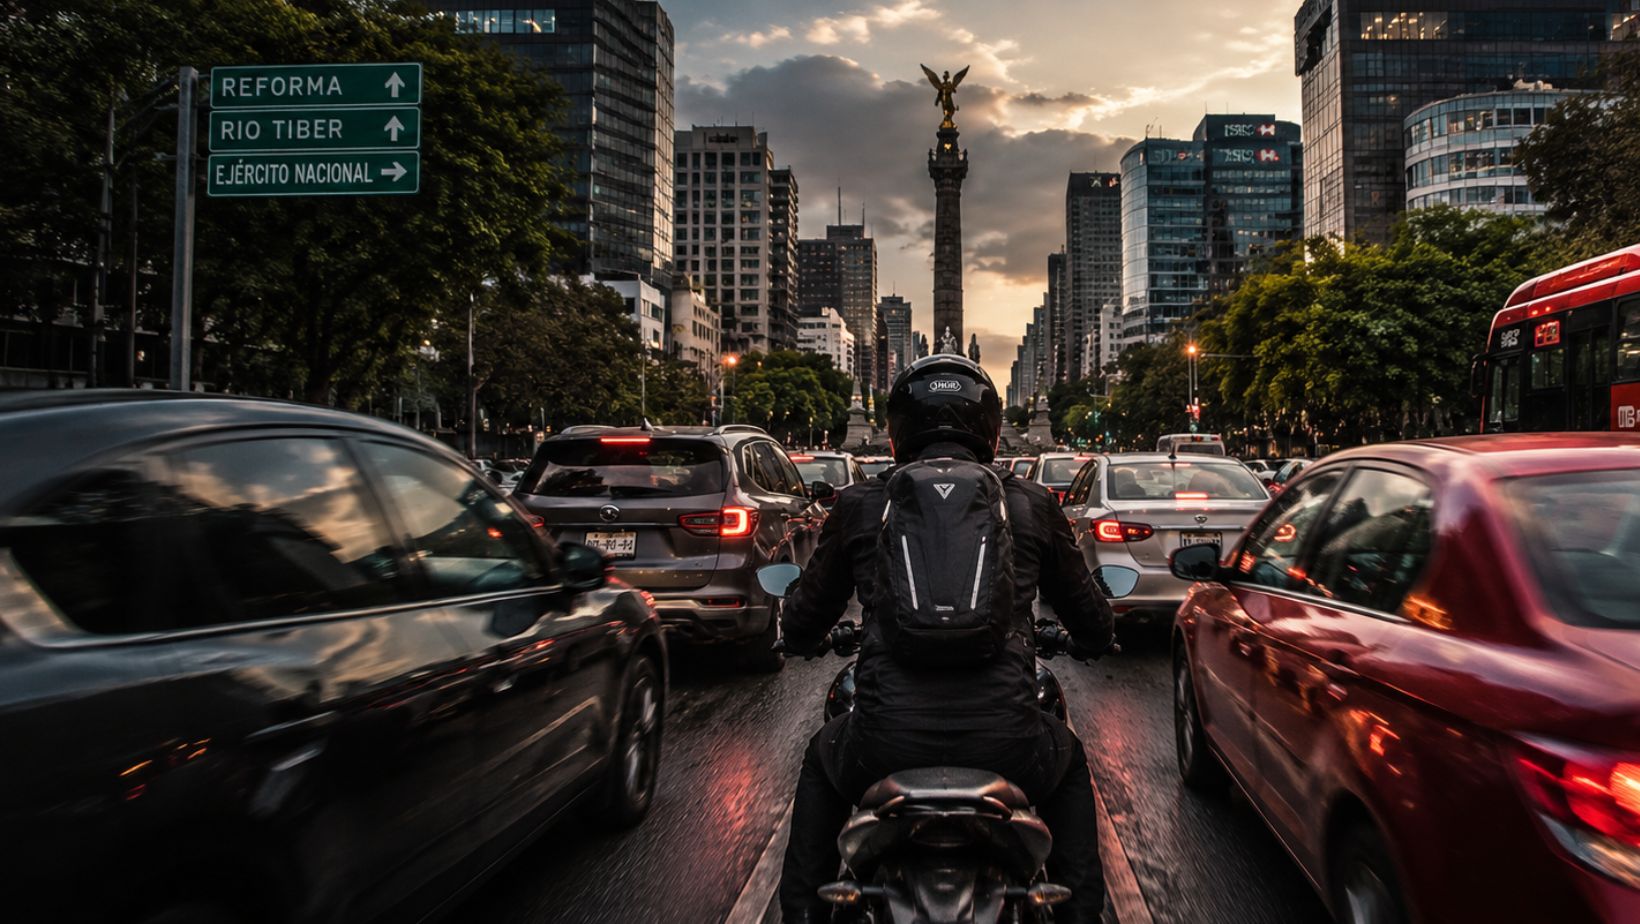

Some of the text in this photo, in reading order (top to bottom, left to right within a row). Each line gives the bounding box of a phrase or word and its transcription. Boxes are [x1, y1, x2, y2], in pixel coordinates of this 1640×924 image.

[221, 75, 343, 97] REFORMA
[221, 119, 343, 140] RIO TIBER
[215, 158, 373, 185] EJÉRCITO NACIONAL
